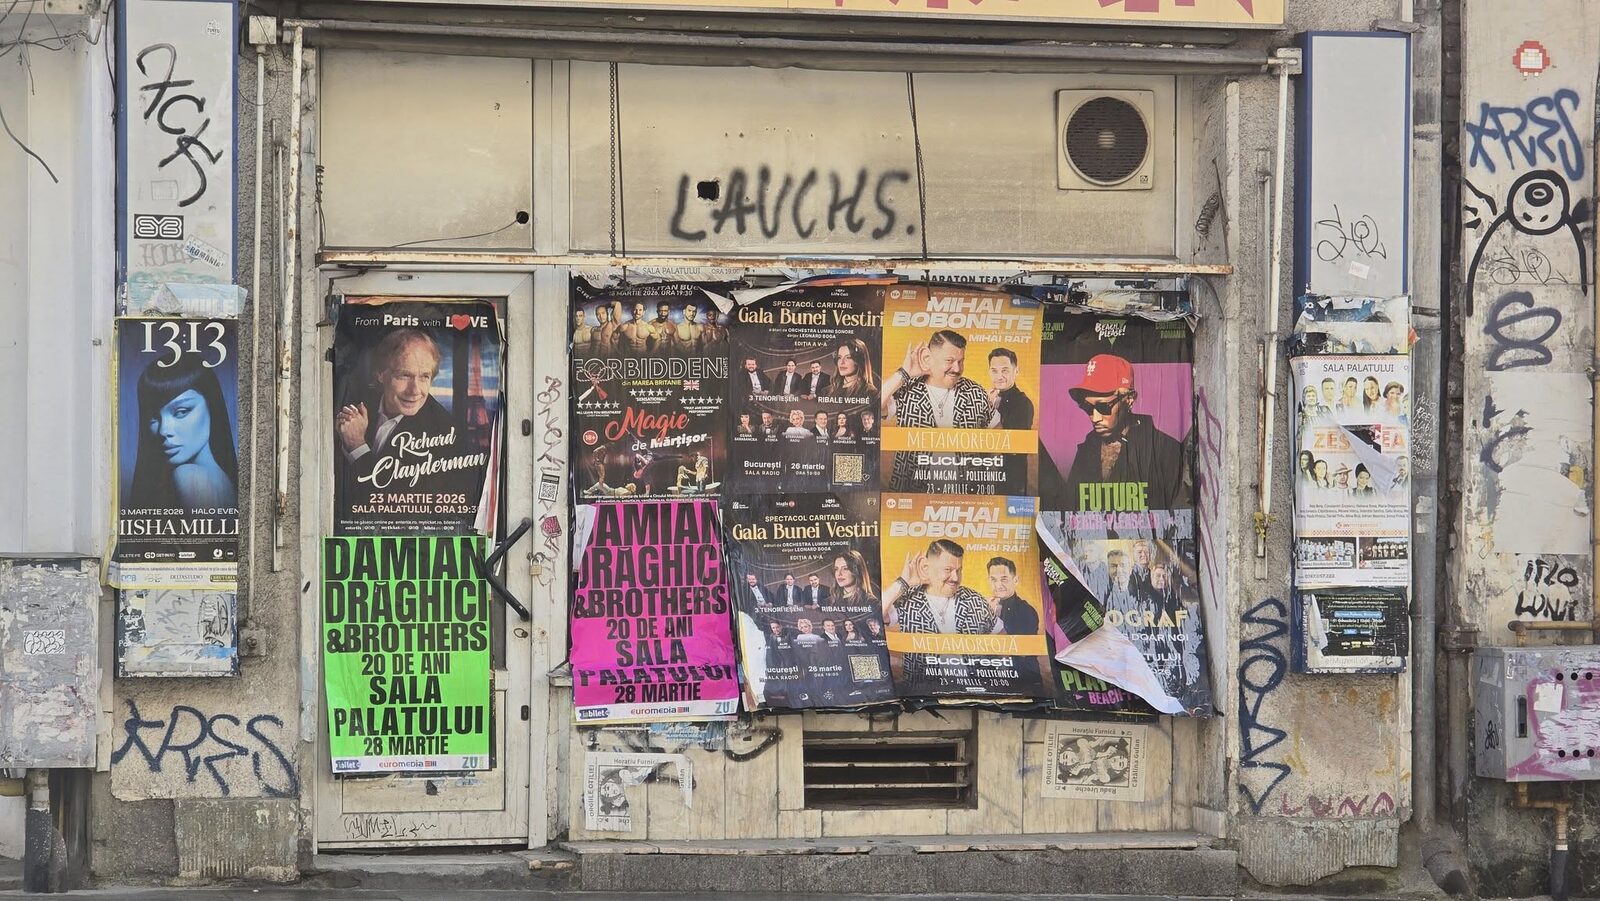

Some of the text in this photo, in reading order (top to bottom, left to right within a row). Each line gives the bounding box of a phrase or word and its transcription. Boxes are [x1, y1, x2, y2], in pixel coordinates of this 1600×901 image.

[926, 297, 1004, 314] MIHAI
[355, 317, 379, 327] From
[384, 314, 418, 327] Paris
[423, 319, 441, 327] with
[738, 308, 884, 327] Gala Bunei Vestiri
[892, 311, 1035, 330] BOBONETE
[969, 334, 1031, 343] MIHAI RAIT
[1323, 364, 1394, 372] SALA PALATULUI
[605, 407, 689, 442] Magie
[391, 427, 456, 458] Richard
[632, 440, 647, 451] de
[1314, 431, 1404, 449] ZESEA
[358, 452, 486, 488] Clayderman
[918, 455, 1003, 470] București
[914, 470, 1006, 482] AULA MAGNA POLITEHNICA
[369, 493, 466, 503] 23 MARTIE 2026
[927, 484, 995, 495] 23 APRILIE 20:00
[1079, 482, 1148, 511] FUTURE
[352, 505, 375, 513] SALA
[378, 505, 432, 514] PALATULUI,
[457, 506, 478, 514] 19:3
[923, 506, 1000, 522] MIHAI
[588, 503, 722, 546] AMIAN
[732, 520, 879, 540] Gala Bunei Vestiri
[890, 521, 1031, 539] BOBONETE
[966, 544, 999, 552] MIHAI
[325, 538, 487, 580] DAMIAN
[325, 581, 487, 623] DRĂGHICI
[574, 586, 727, 618] &BROTHERS
[1106, 609, 1188, 627] OGRAF
[606, 617, 693, 639] 20 DE ANI
[1168, 633, 1188, 641] NOI
[327, 622, 487, 653] &BROTHERS
[616, 639, 688, 667] SALA
[362, 653, 450, 675] 20 DE ANI
[926, 657, 1013, 669] București
[925, 668, 942, 676] AULA
[944, 668, 968, 677] MAGNA
[370, 676, 441, 705] SALA
[615, 683, 700, 704] 28 MARTIE
[1089, 691, 1132, 705] BEACH-
[334, 706, 483, 736] PALATULUI
[364, 736, 448, 756] 28 MARTIE
